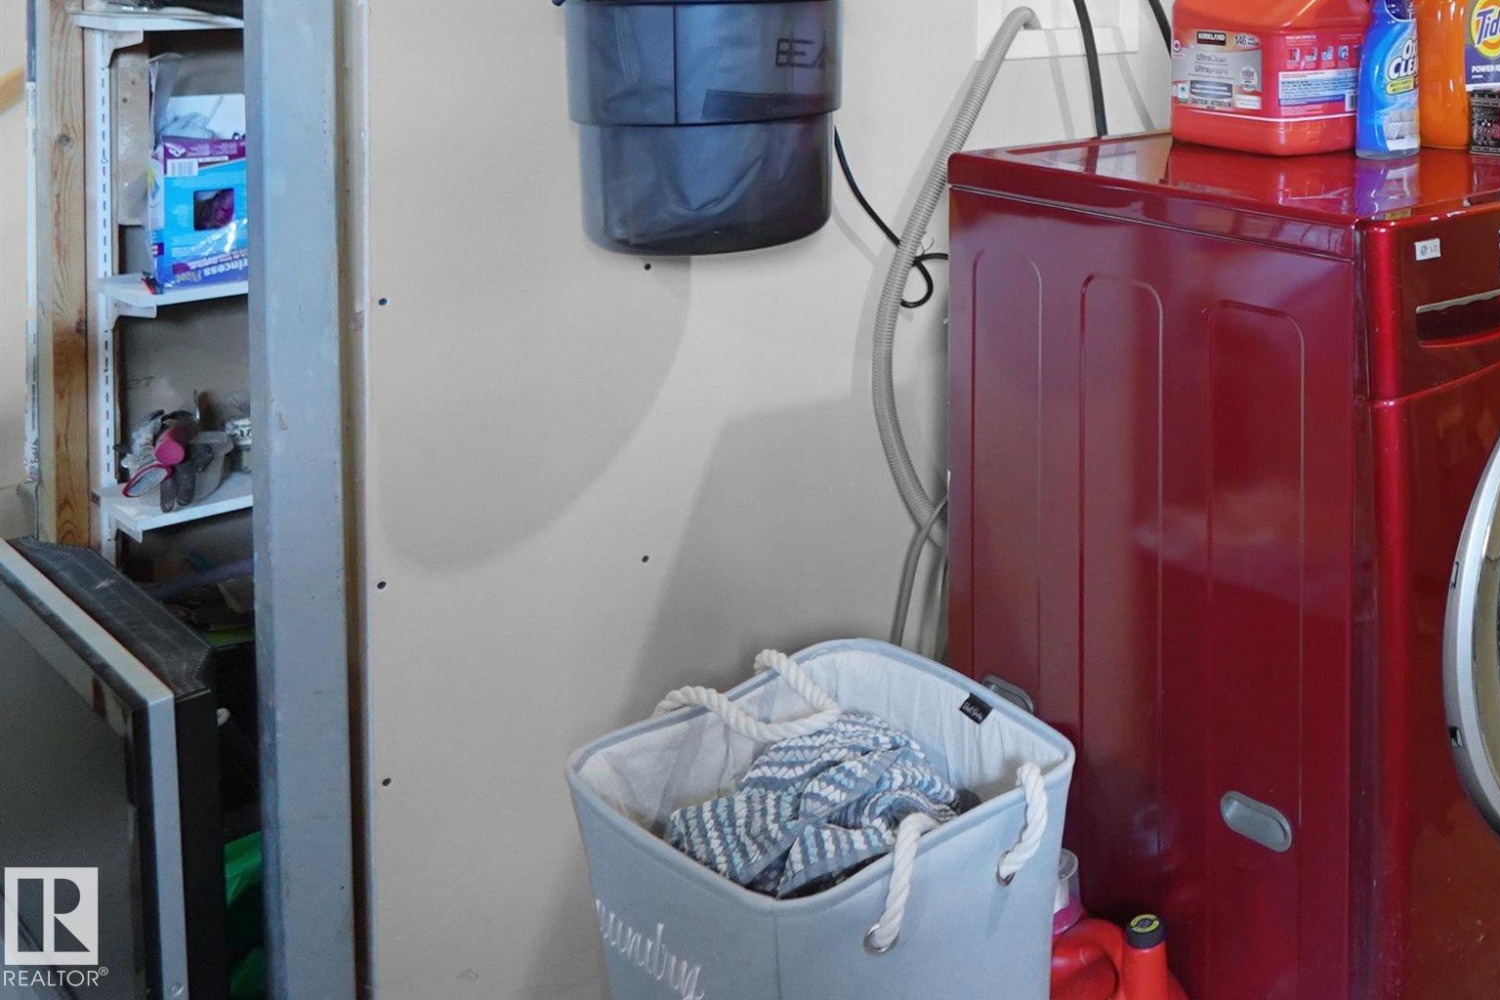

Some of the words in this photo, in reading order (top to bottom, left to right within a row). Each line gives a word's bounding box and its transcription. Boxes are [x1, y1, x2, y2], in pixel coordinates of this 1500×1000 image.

[1198, 32, 1226, 41] KIRKLAND
[1472, 65, 1495, 73] POWER
[203, 258, 248, 277] rincess
